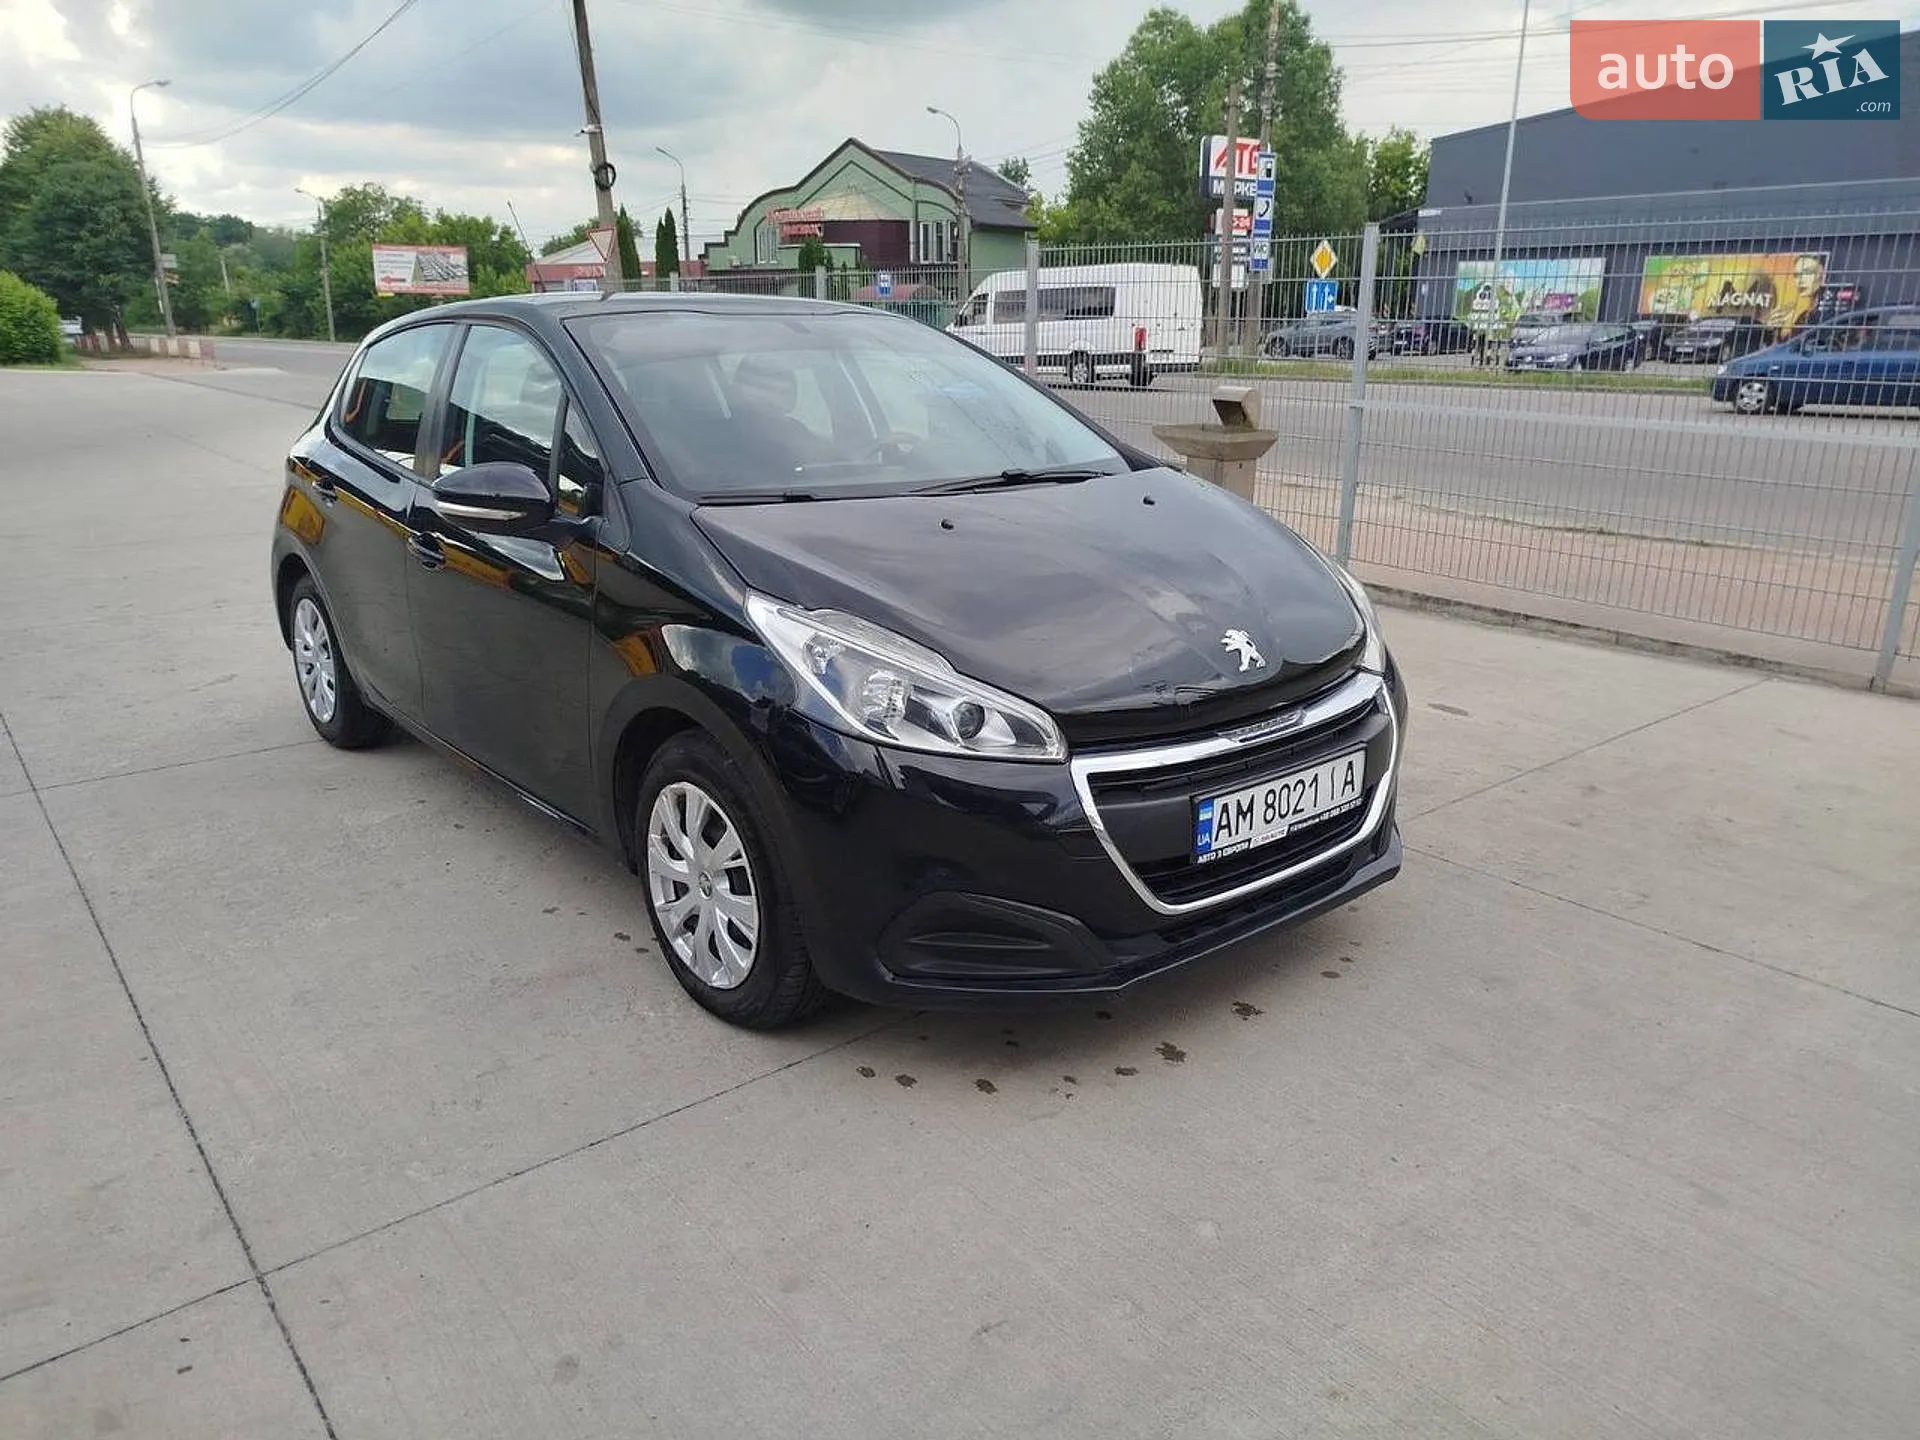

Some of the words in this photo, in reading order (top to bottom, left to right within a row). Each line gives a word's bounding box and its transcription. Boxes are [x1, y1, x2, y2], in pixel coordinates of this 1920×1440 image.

[1213, 179, 1257, 196] МРКЕ
[1214, 793, 1255, 842] AM
[1263, 773, 1319, 825] 8021
[1197, 832, 1210, 846] UA
